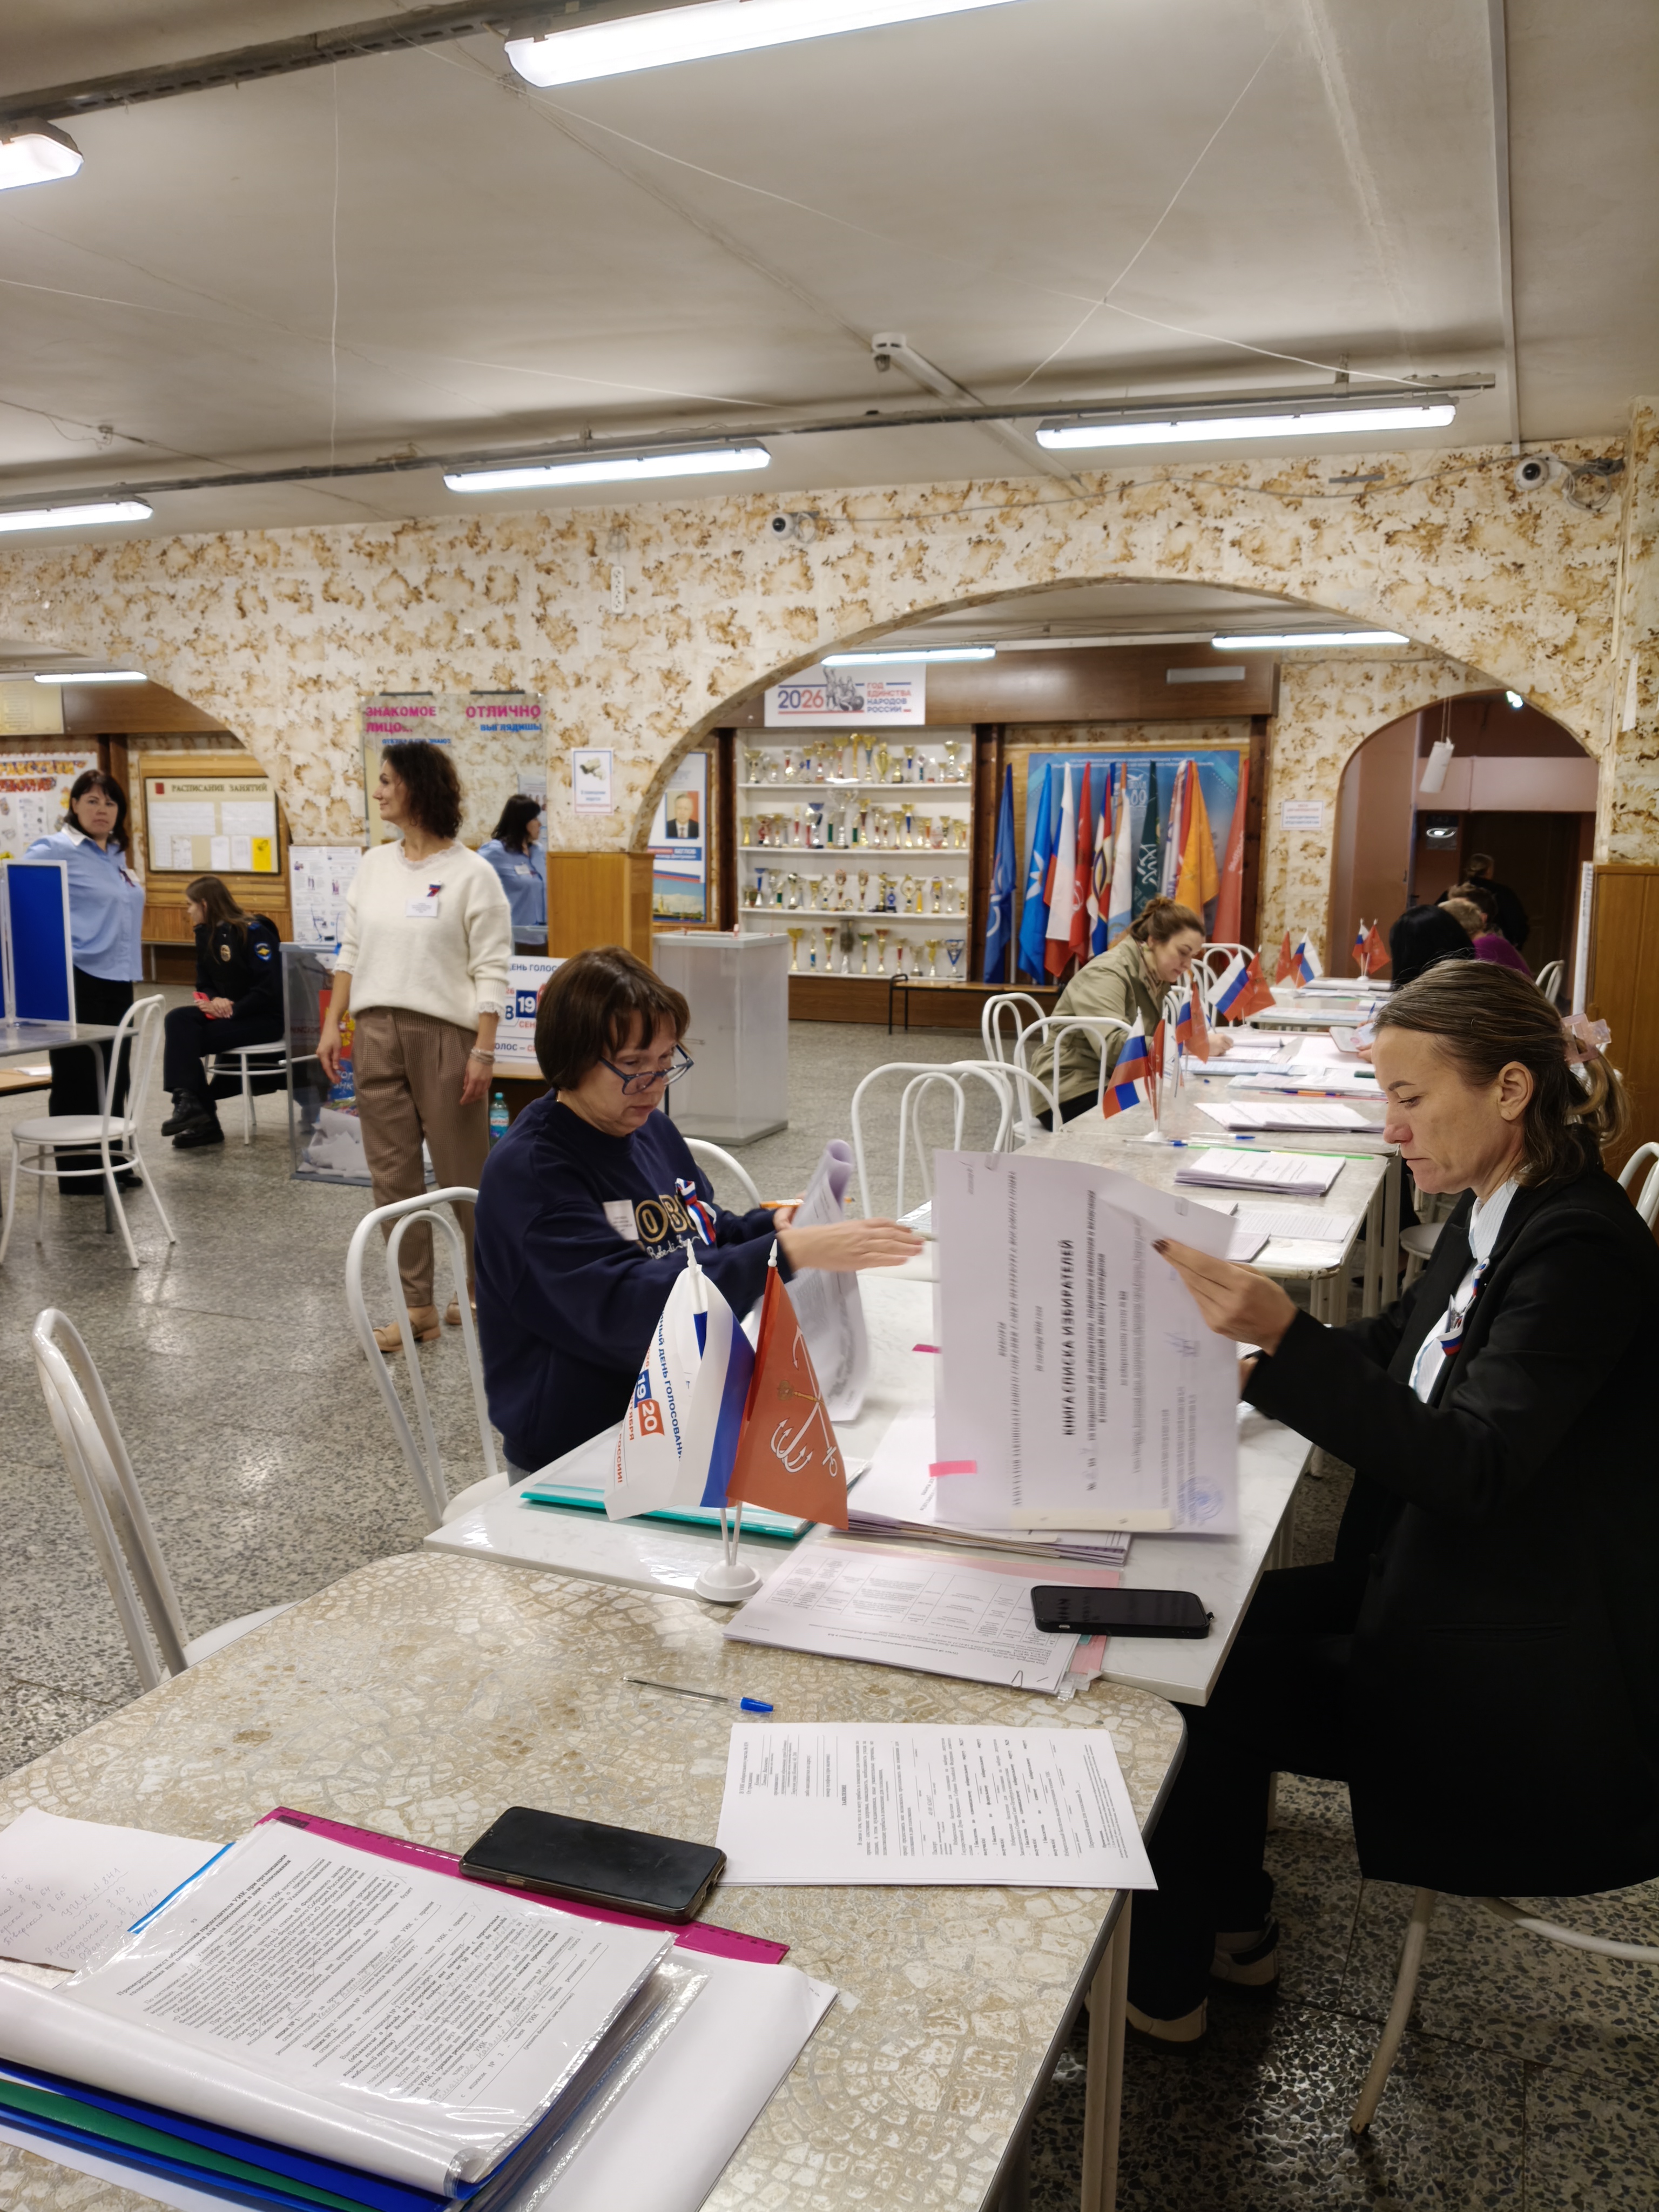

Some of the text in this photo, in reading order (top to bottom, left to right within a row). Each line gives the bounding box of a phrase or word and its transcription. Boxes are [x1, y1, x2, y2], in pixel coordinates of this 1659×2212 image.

[778, 690, 824, 709] 2026
[365, 706, 436, 717] ЗНАКОМОЕ
[466, 705, 542, 718] ОТЛИЧНО
[171, 782, 268, 793] РАСПИСАНИЕ ЗАНЯТИЙ
[510, 963, 561, 972] ЕНЬ ГОЛОС
[518, 996, 536, 1014] 19
[519, 1021, 536, 1029] СЕН
[495, 1043, 517, 1051] ОЛОС
[1057, 1239, 1075, 1435] КНИГА СПИСКА ИЗБИРАТЕЛЕЙ
[658, 1348, 668, 1378] ДЕНЬ
[635, 1374, 657, 1431] 19 20
[116, 1854, 287, 1995] Примерный текст объявления председателя УИК при организации
[129, 1970, 165, 1995] голосования
[164, 1961, 176, 1970] вне
[174, 1936, 207, 1961] помещения
[205, 1927, 217, 1936] для
[215, 1899, 248, 1927] голосования
[251, 1886, 262, 1896] дни
[260, 1859, 291, 1887] голосования
